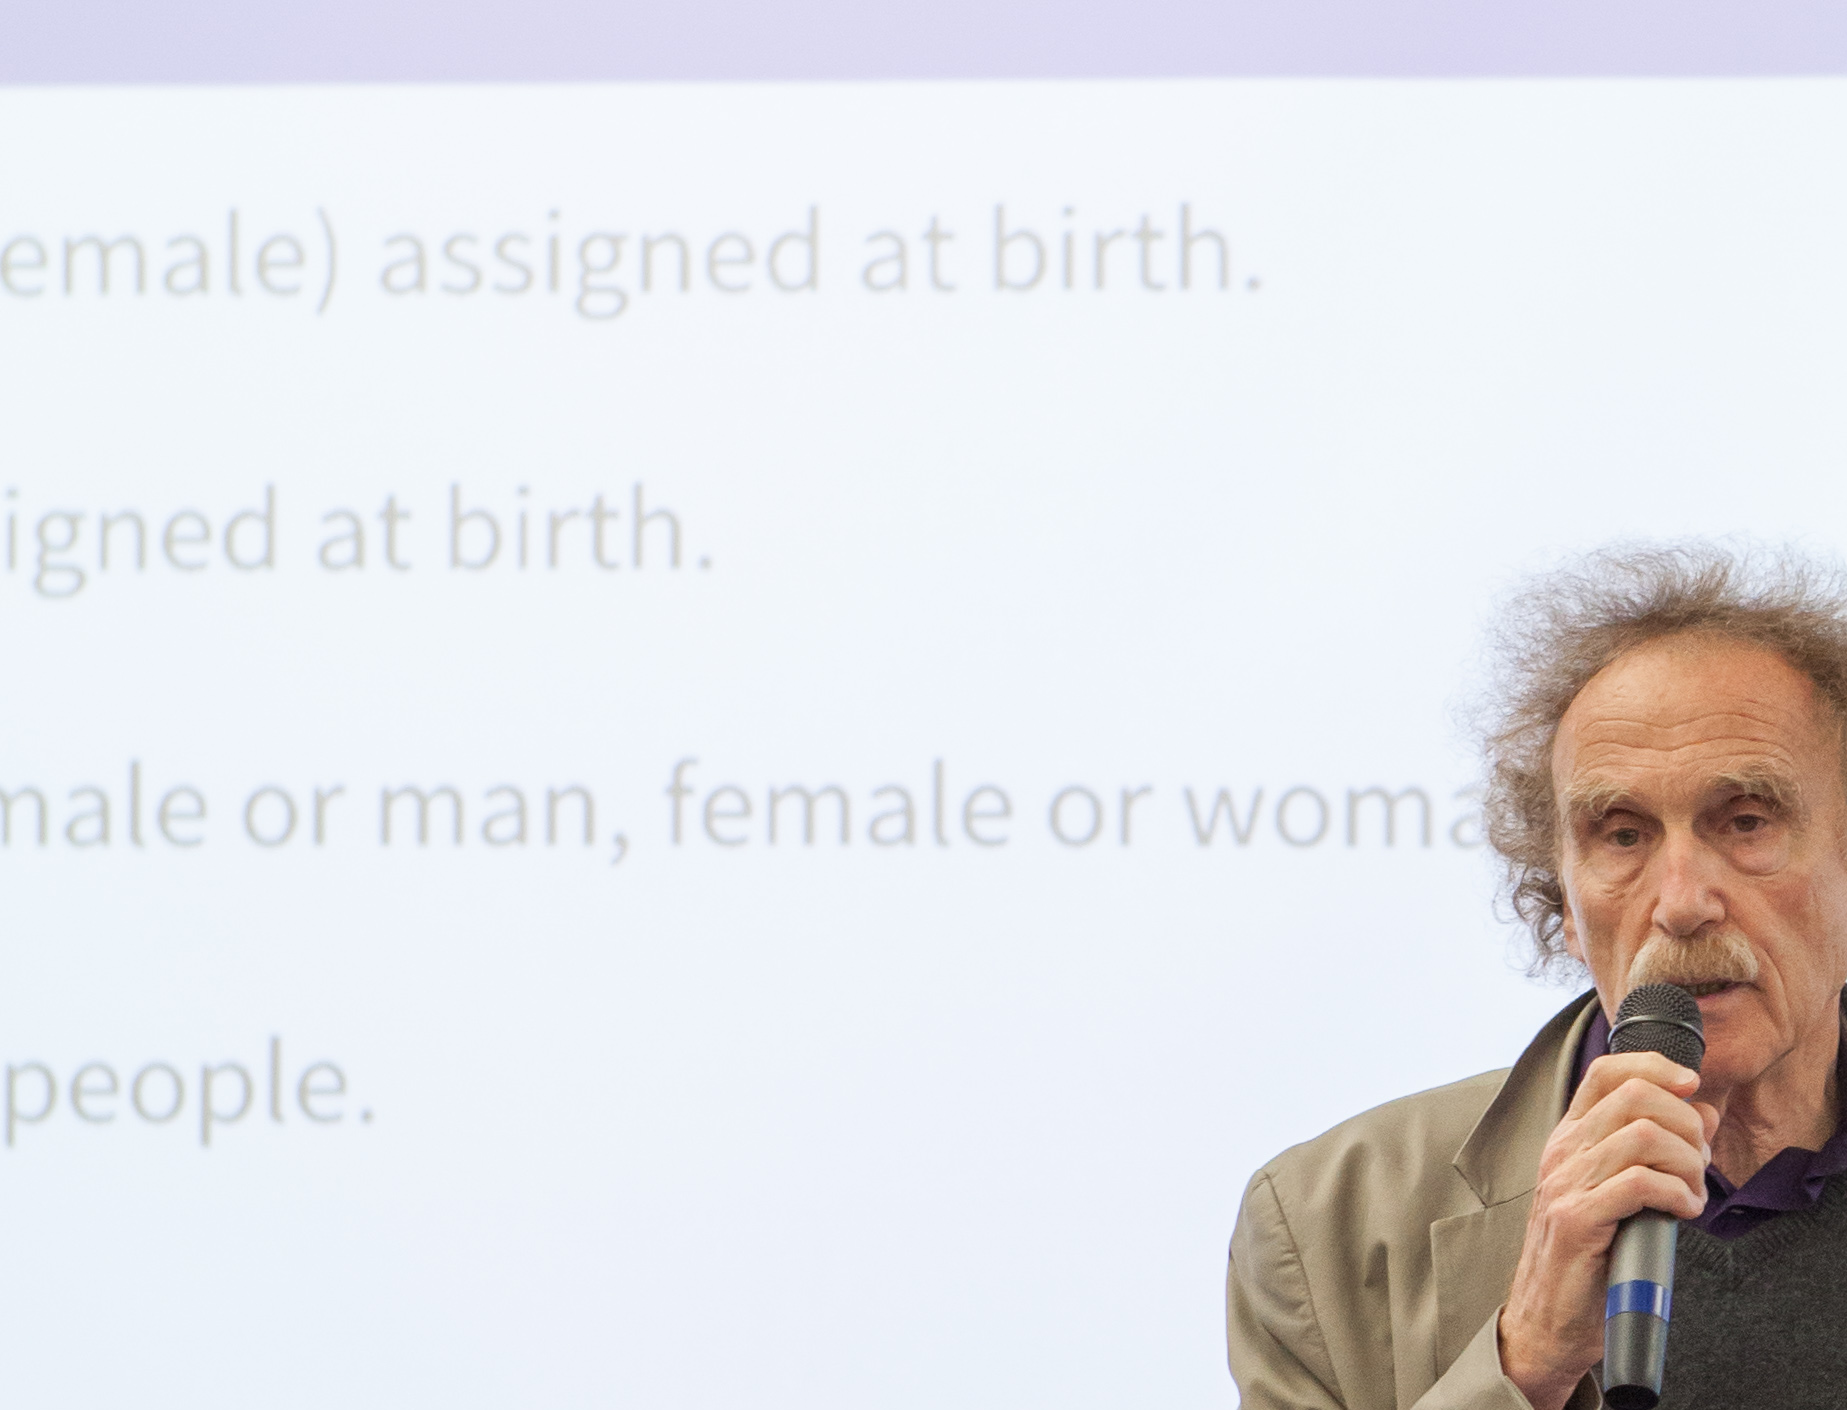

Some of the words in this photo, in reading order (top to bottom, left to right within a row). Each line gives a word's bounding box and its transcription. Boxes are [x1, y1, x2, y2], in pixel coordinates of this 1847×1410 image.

[0, 206, 336, 315] emale)
[378, 205, 820, 321] assigned
[860, 215, 957, 293] at
[992, 202, 1263, 293] birth.
[5, 483, 276, 600] igned
[316, 493, 412, 572] at
[447, 481, 714, 572] birth.
[0, 757, 208, 849] male
[240, 783, 346, 849] or
[377, 782, 630, 866] man,
[663, 755, 1014, 849] female
[1046, 783, 1154, 849] or
[2, 1034, 375, 1149] people.
